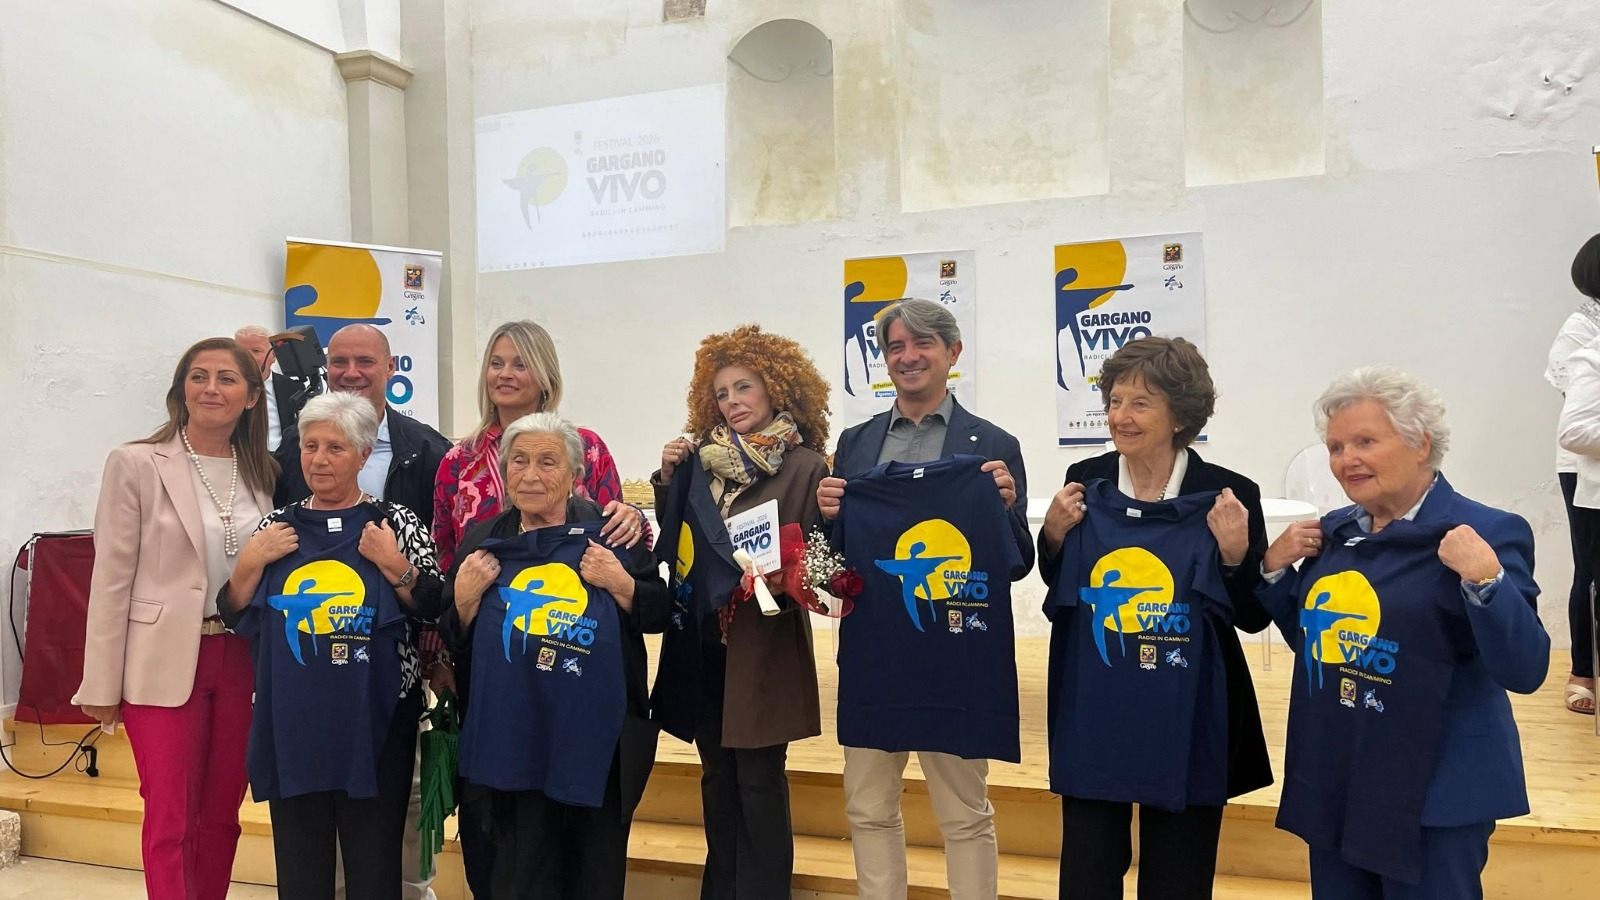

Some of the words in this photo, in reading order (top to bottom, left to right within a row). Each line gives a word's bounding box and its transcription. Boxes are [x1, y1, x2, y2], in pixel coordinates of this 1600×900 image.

[593, 137, 633, 151] FESTIVAL
[638, 134, 660, 145] 2026
[586, 149, 666, 174] GARGANO
[586, 169, 667, 205] VIVO
[1080, 311, 1152, 327] GARGANO
[733, 521, 771, 543] GARGANO
[943, 570, 989, 582] GARGANO
[943, 581, 989, 600] VIVO
[1137, 602, 1190, 614] GARGANO
[548, 609, 598, 630] GARGANO
[1136, 614, 1190, 634] VIVO
[546, 619, 595, 646] VIVO
[1338, 629, 1400, 654] GARGANO
[1338, 642, 1396, 674] VIVO
